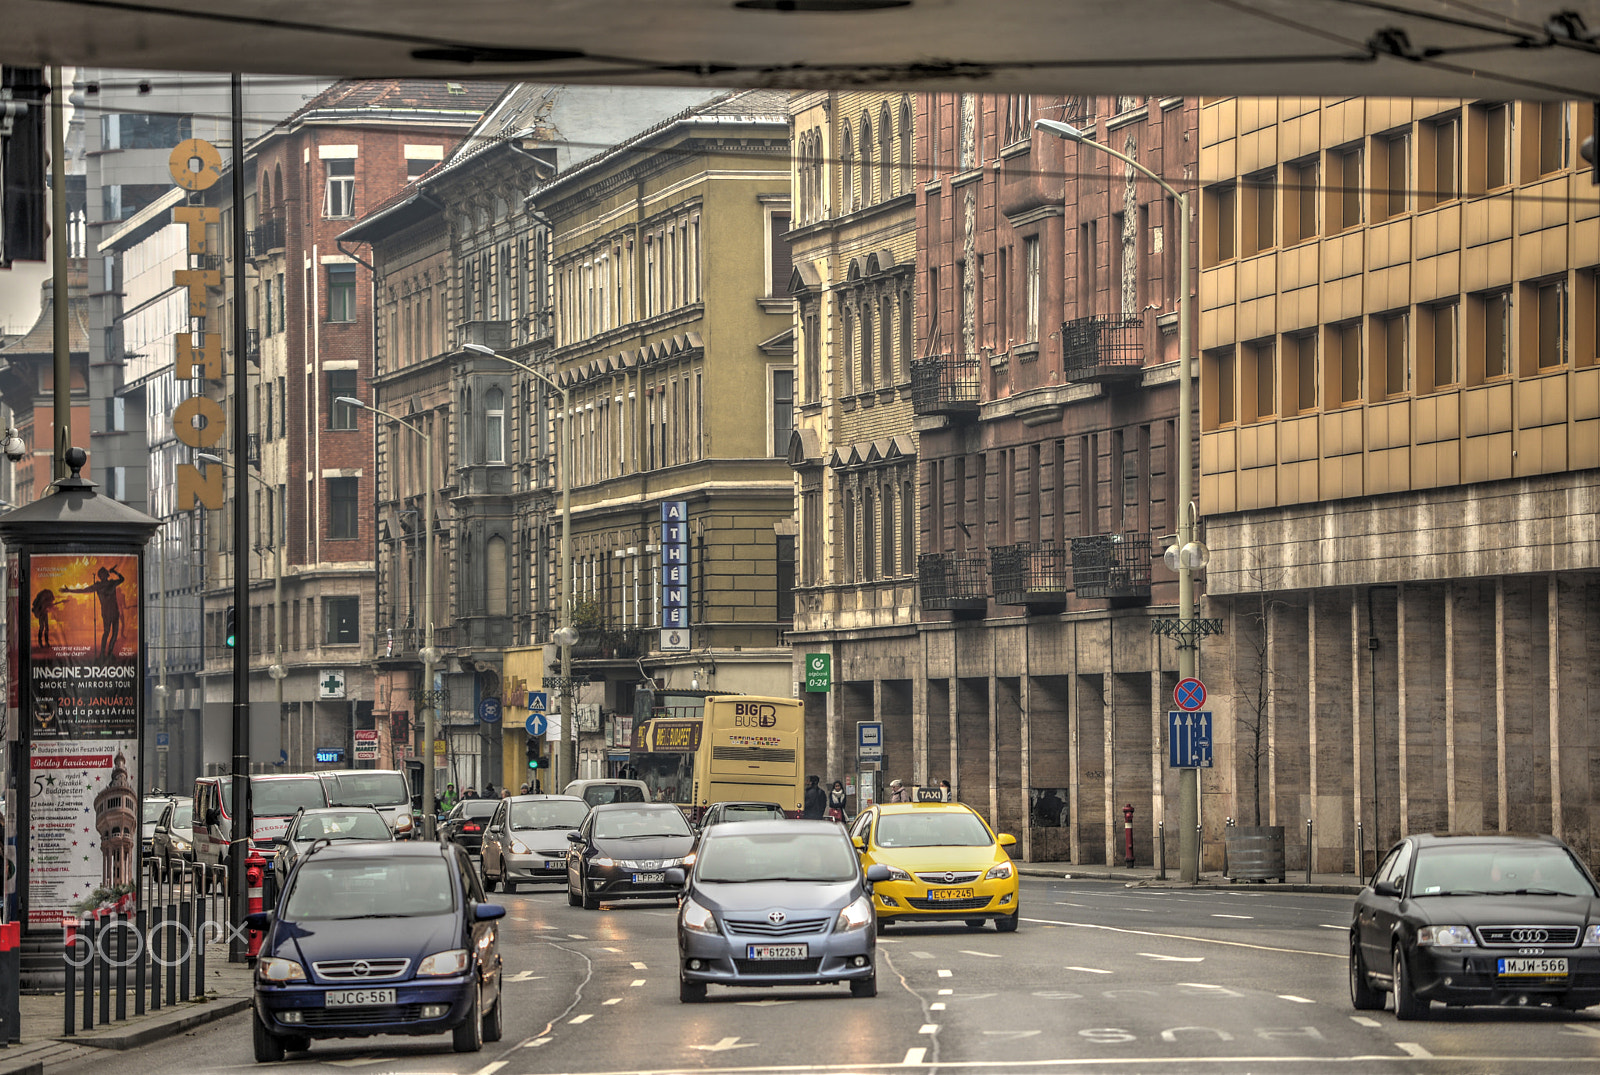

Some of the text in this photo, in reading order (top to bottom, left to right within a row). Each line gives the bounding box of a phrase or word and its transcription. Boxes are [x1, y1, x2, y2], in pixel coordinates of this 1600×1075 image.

[169, 138, 226, 510] OTTHON
[669, 506, 682, 622] ATHÉNÉ
[33, 666, 135, 679] IMAGINE DRAGONS
[40, 681, 67, 689] SMOKE
[78, 681, 113, 689] MIRRORS
[115, 680, 131, 688] TOUR
[809, 678, 827, 687] 0-24
[58, 696, 86, 707] 2016.
[88, 694, 123, 706] JANUÁR
[735, 703, 758, 716] BIG
[735, 715, 758, 728] BUS
[63, 758, 109, 767] karácsonyt!
[46, 787, 84, 796] Budapesten
[919, 791, 941, 800] TAXI
[934, 889, 972, 900] ECY-245
[756, 948, 763, 957] W
[769, 947, 797, 957] 61226
[1507, 959, 1566, 972] MJW-566
[337, 990, 393, 1005] JCG-561
